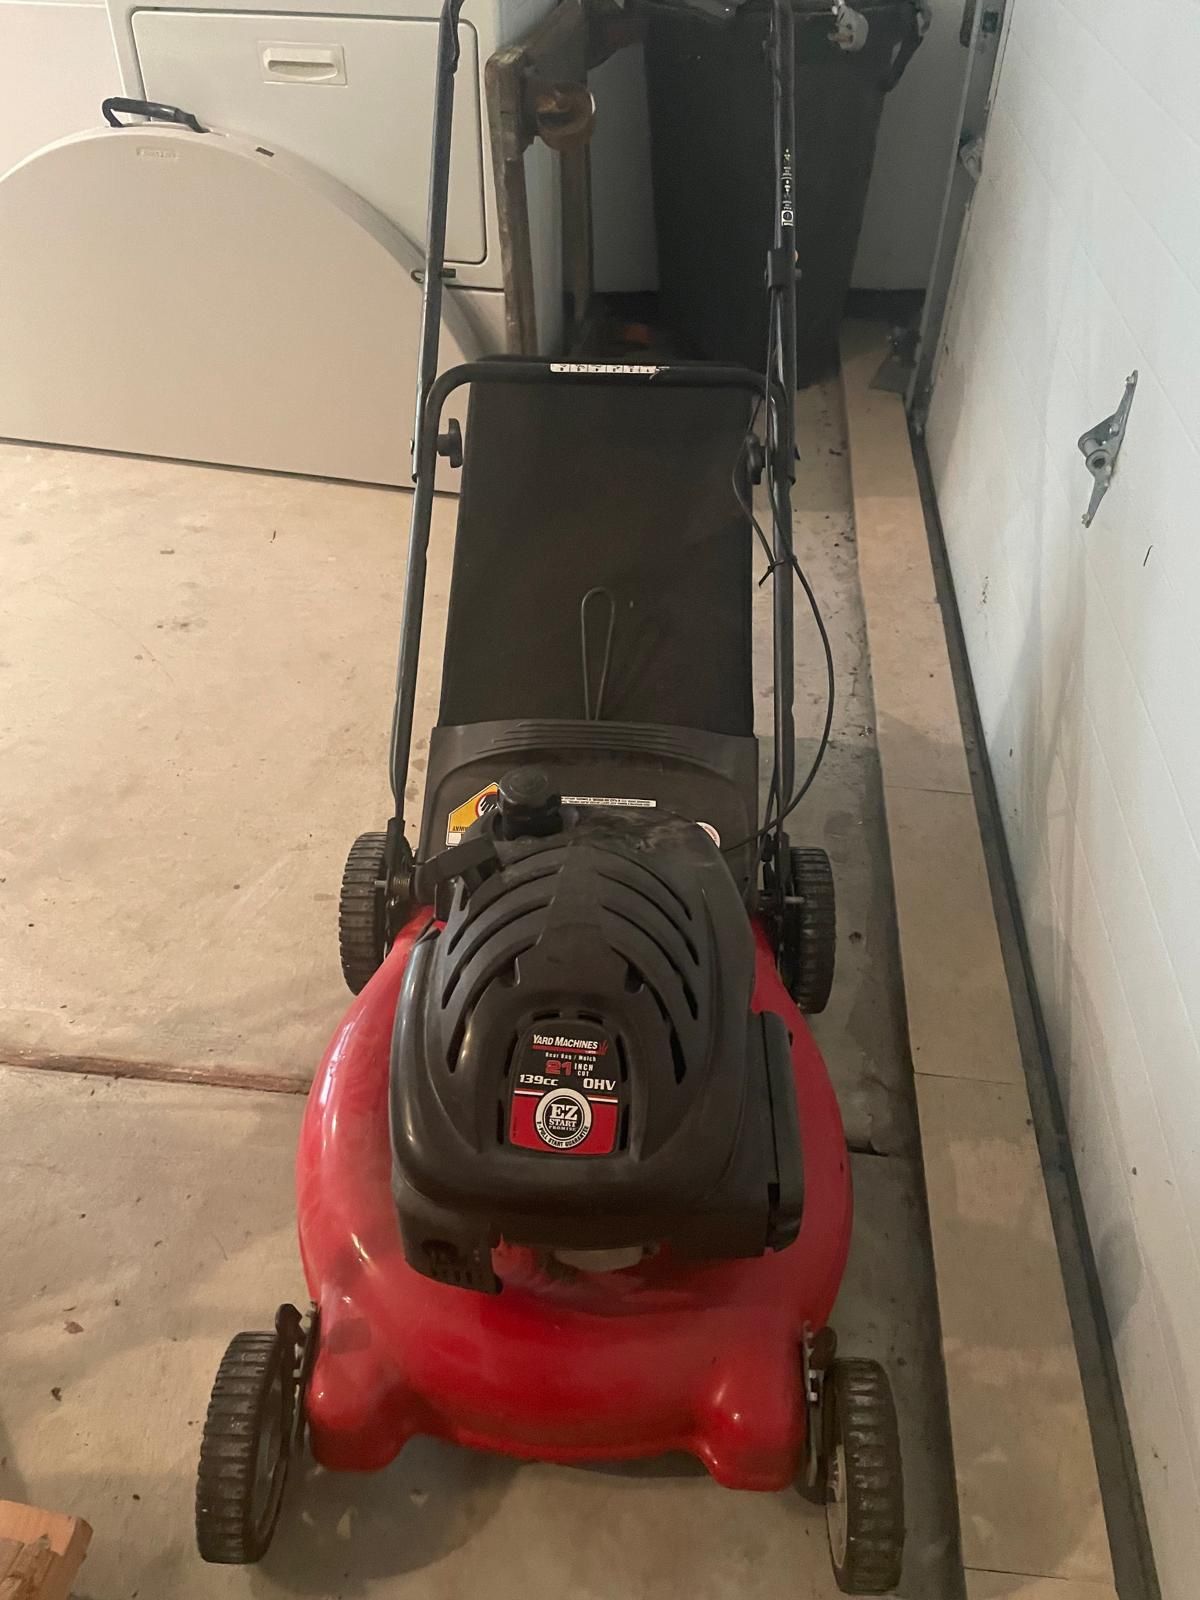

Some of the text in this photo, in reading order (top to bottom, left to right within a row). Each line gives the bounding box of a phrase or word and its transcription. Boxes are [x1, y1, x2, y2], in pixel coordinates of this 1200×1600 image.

[533, 1034, 599, 1050] YARD MACHINES
[545, 1060, 594, 1076] 21 INCH
[583, 1078, 616, 1091] OHV
[549, 1103, 579, 1120] EZ
[548, 1118, 577, 1127] START
